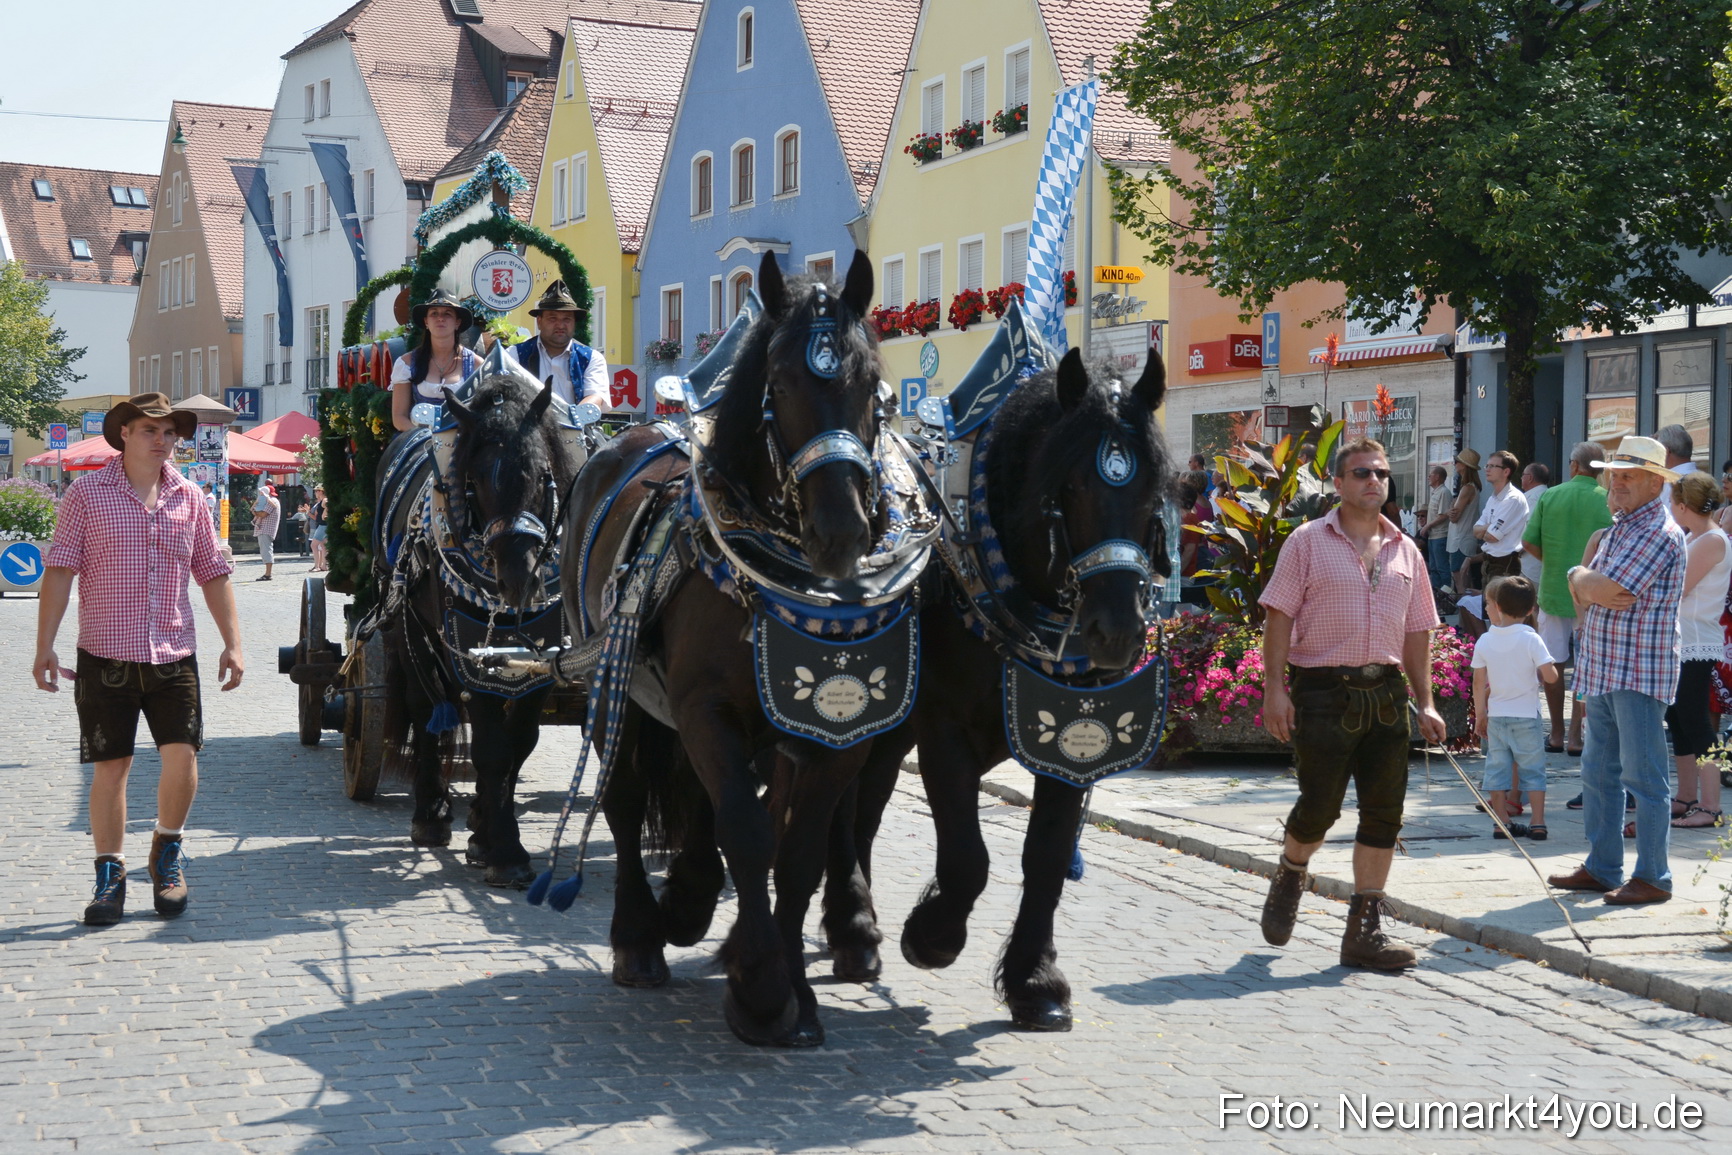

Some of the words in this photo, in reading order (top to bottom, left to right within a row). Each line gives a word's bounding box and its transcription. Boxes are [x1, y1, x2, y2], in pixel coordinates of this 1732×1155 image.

[481, 260, 507, 270] Winkler
[1102, 269, 1123, 280] KINO
[1266, 319, 1277, 358] P
[1235, 344, 1260, 357] DER
[1189, 354, 1204, 370] DER
[907, 382, 921, 413] P
[1477, 384, 1486, 399] 16
[1347, 410, 1370, 423] MARIO
[1347, 425, 1361, 435] Frisch
